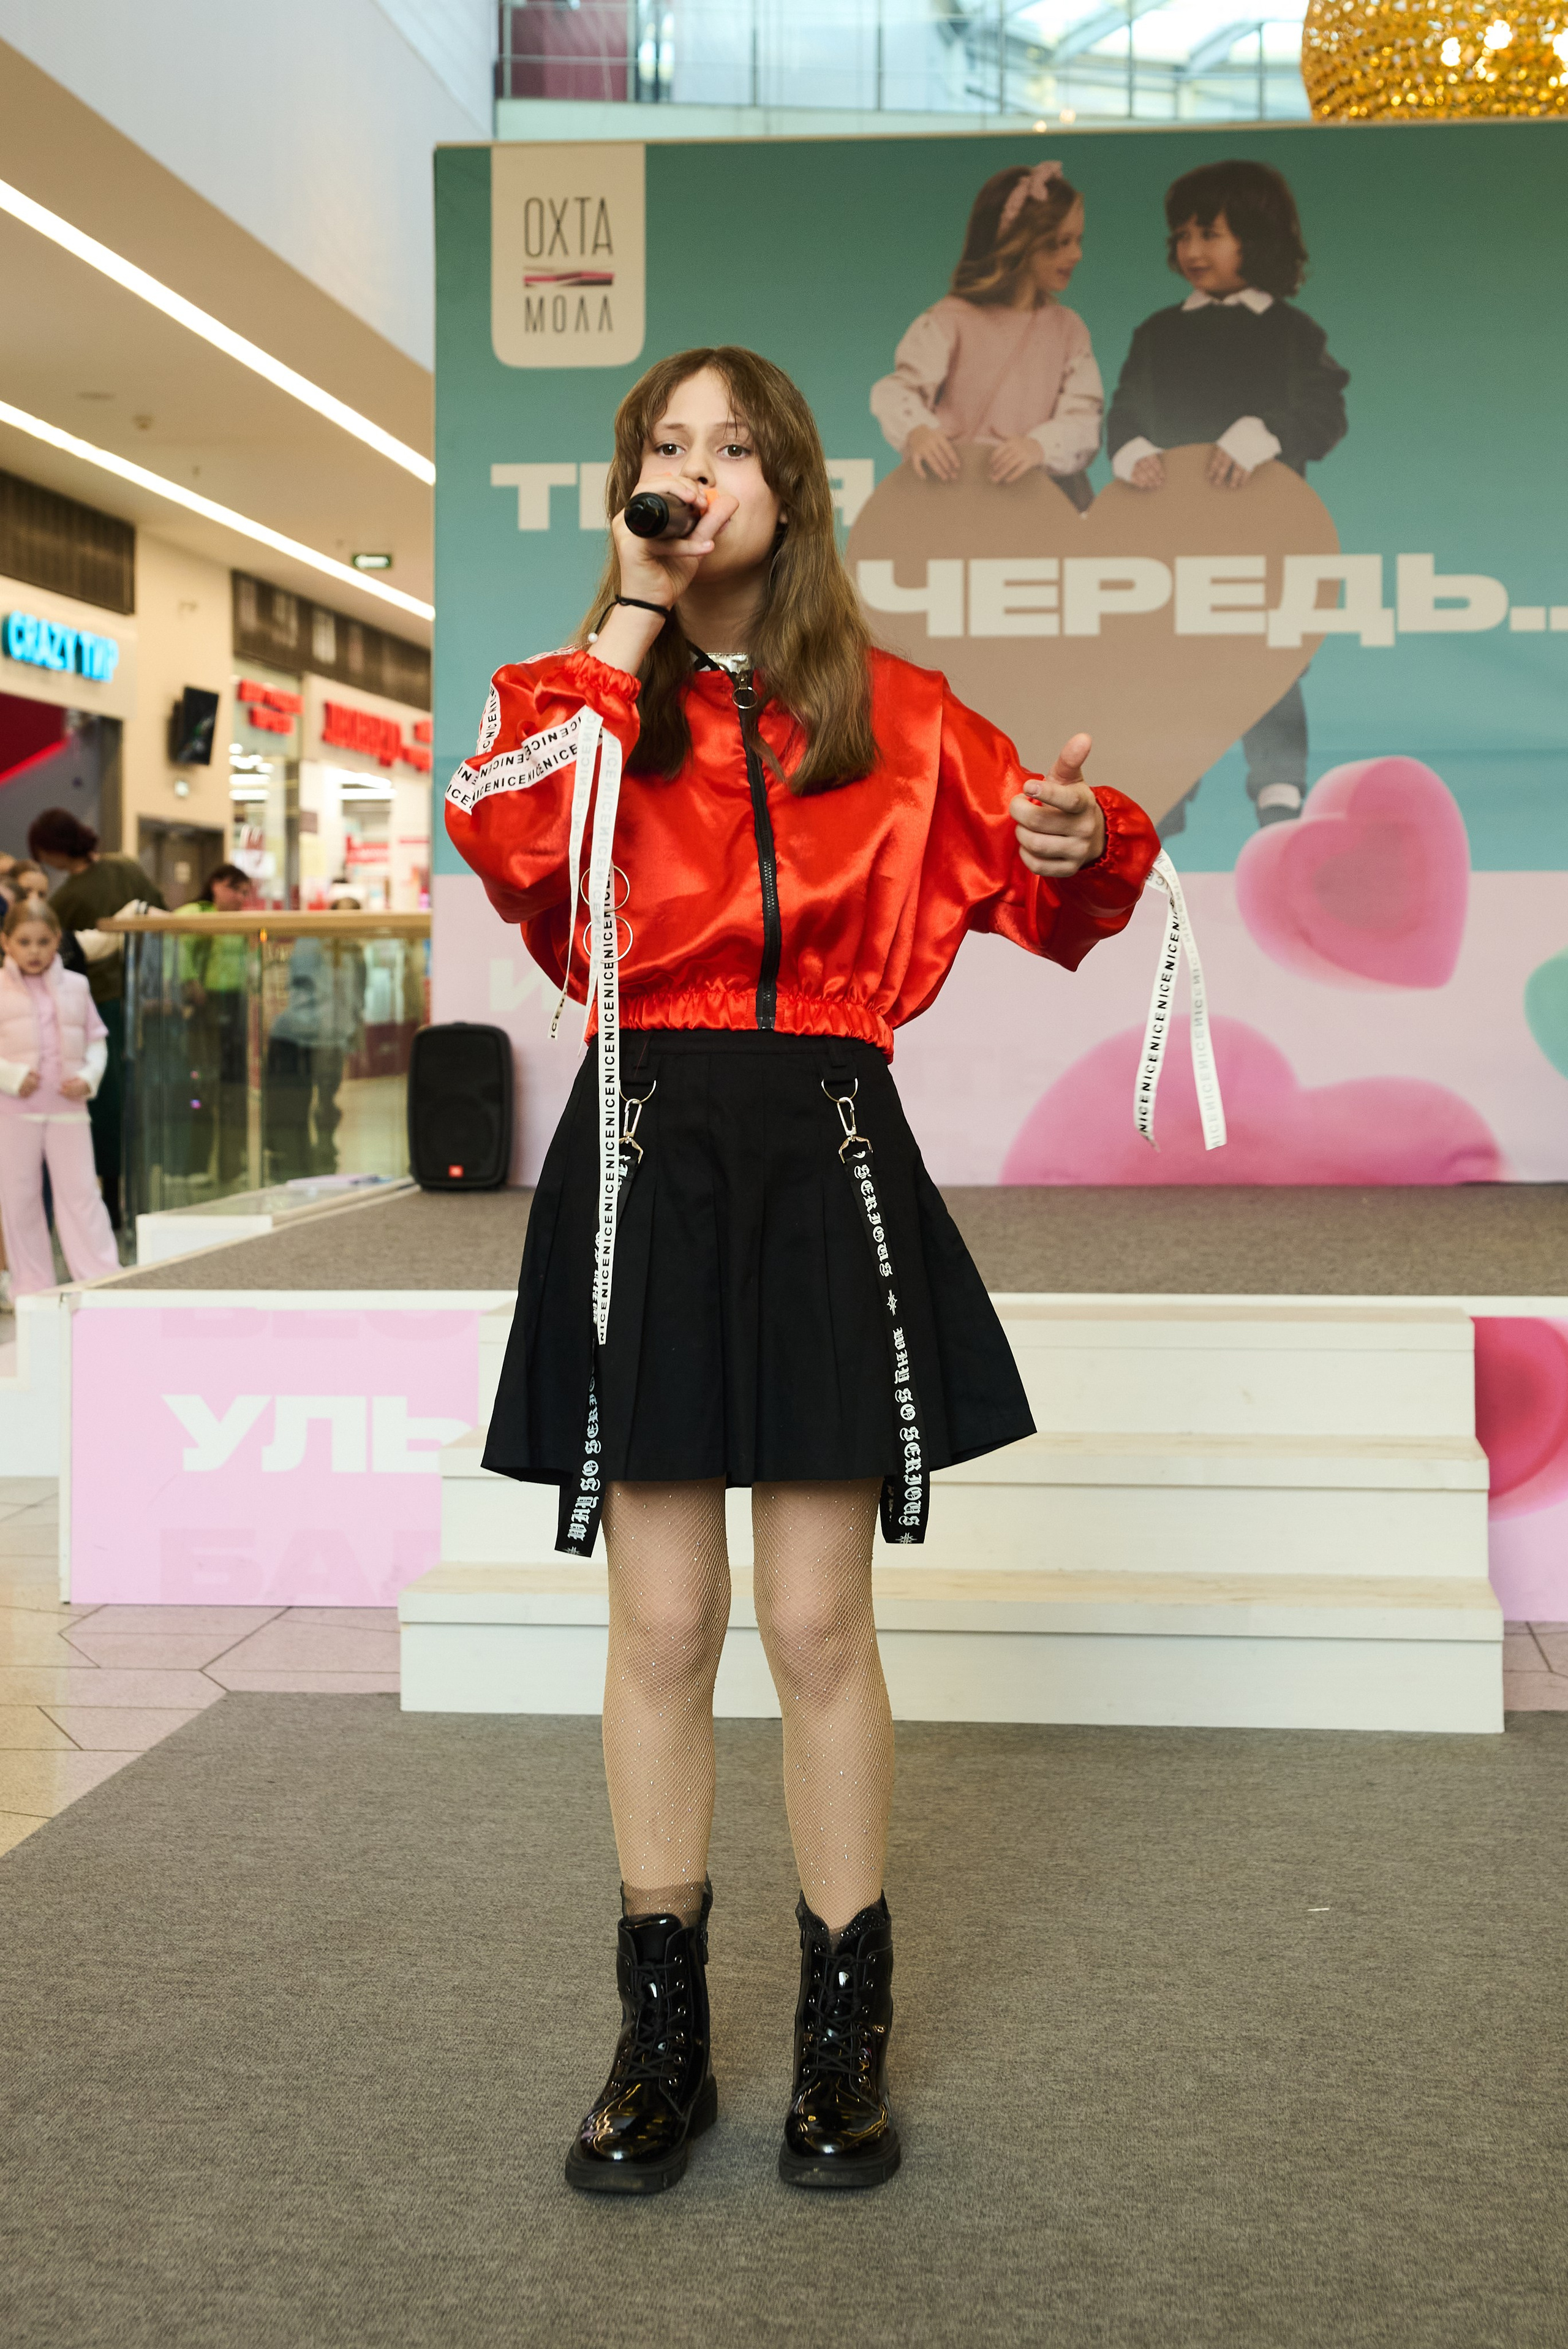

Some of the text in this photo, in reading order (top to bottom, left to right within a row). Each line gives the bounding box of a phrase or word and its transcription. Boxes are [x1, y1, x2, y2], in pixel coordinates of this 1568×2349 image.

[523, 197, 614, 258] ОХТА
[895, 1388, 916, 1421] SO
[580, 1459, 601, 1492] SO
[899, 1426, 922, 1527] SERIOUS
